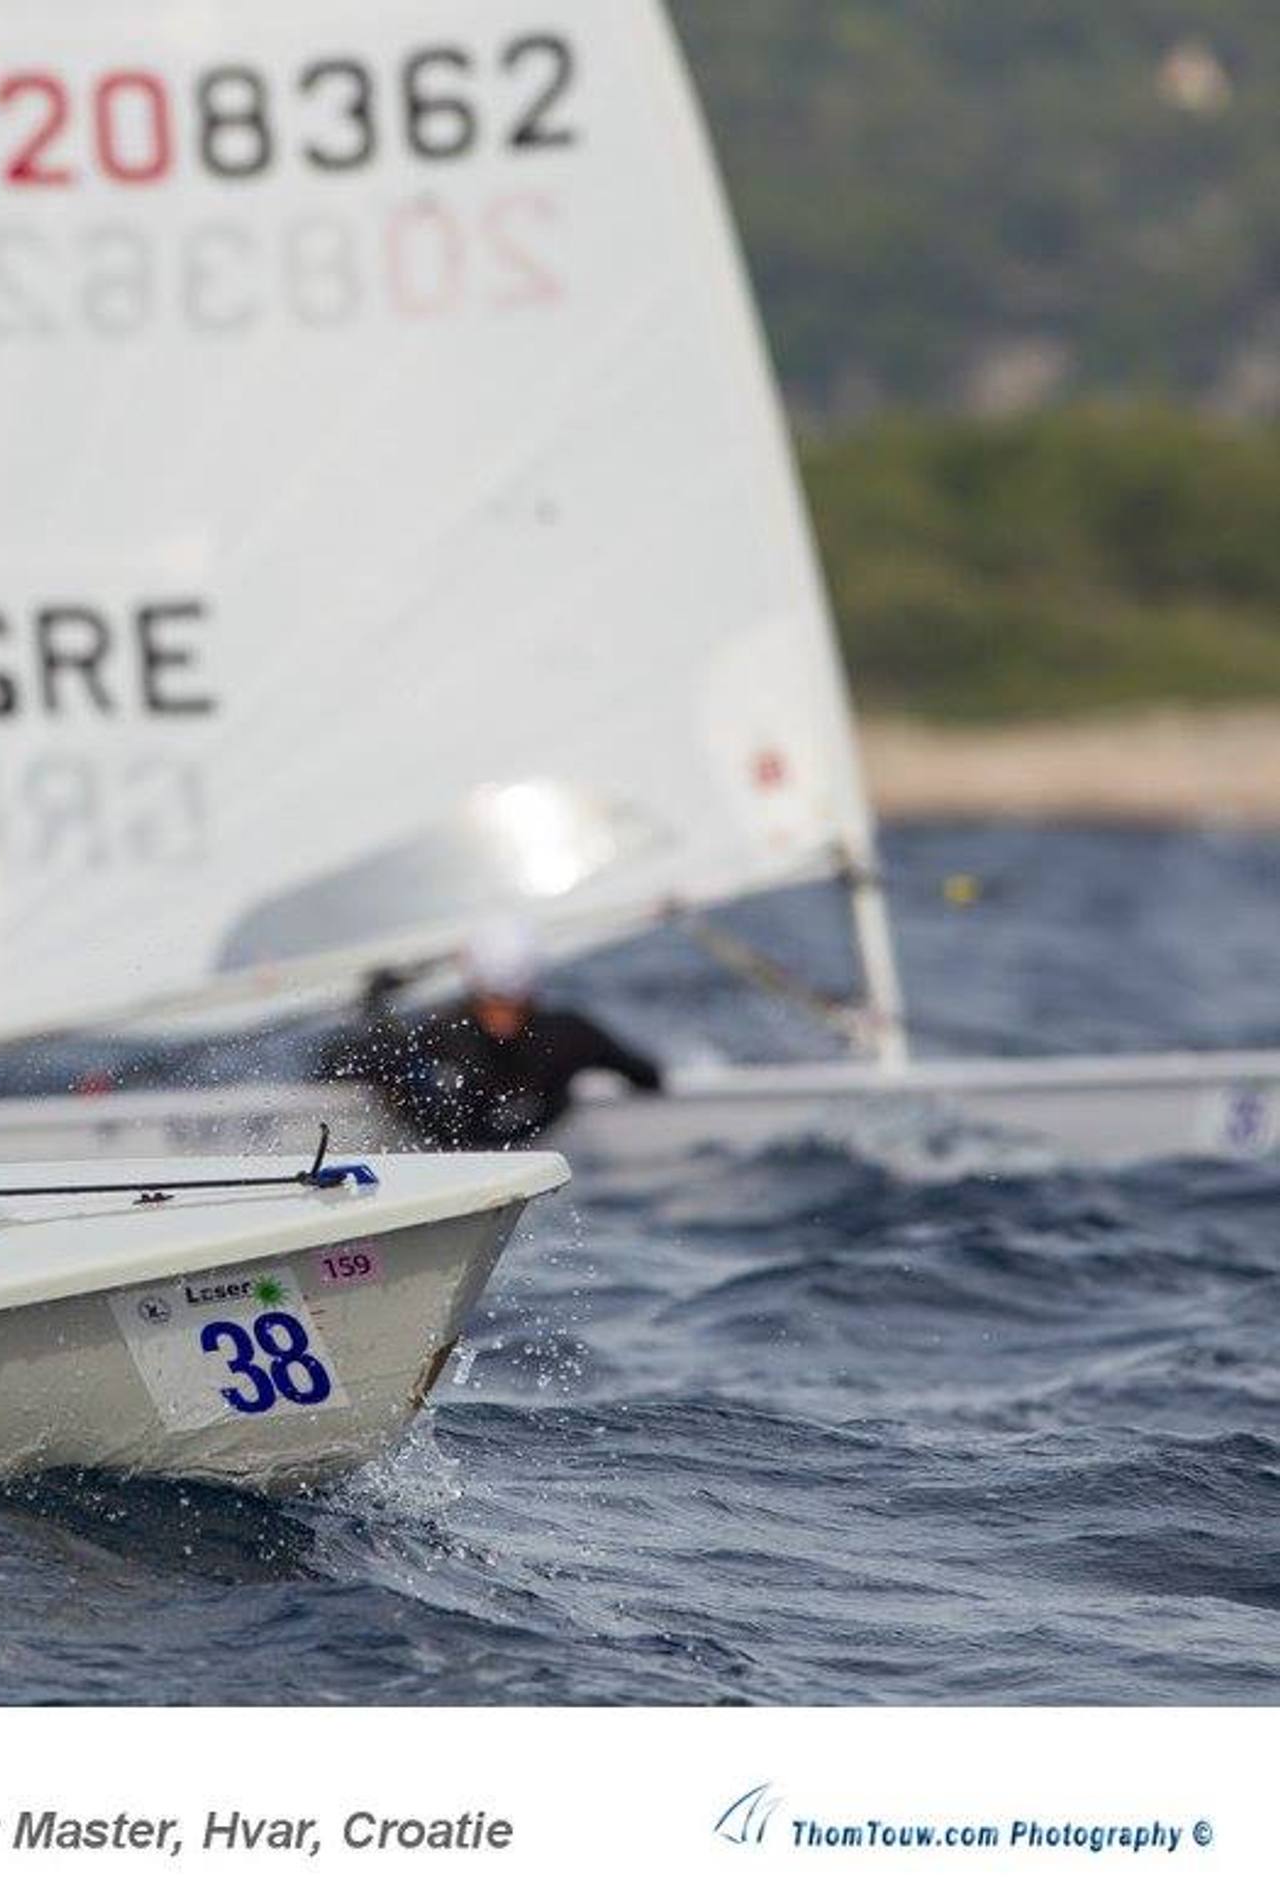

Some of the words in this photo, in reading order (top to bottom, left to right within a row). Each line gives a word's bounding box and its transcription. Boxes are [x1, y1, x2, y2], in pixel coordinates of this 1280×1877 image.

[323, 1254, 371, 1280] 159
[184, 1279, 252, 1304] Laser
[199, 1311, 332, 1415] 38
